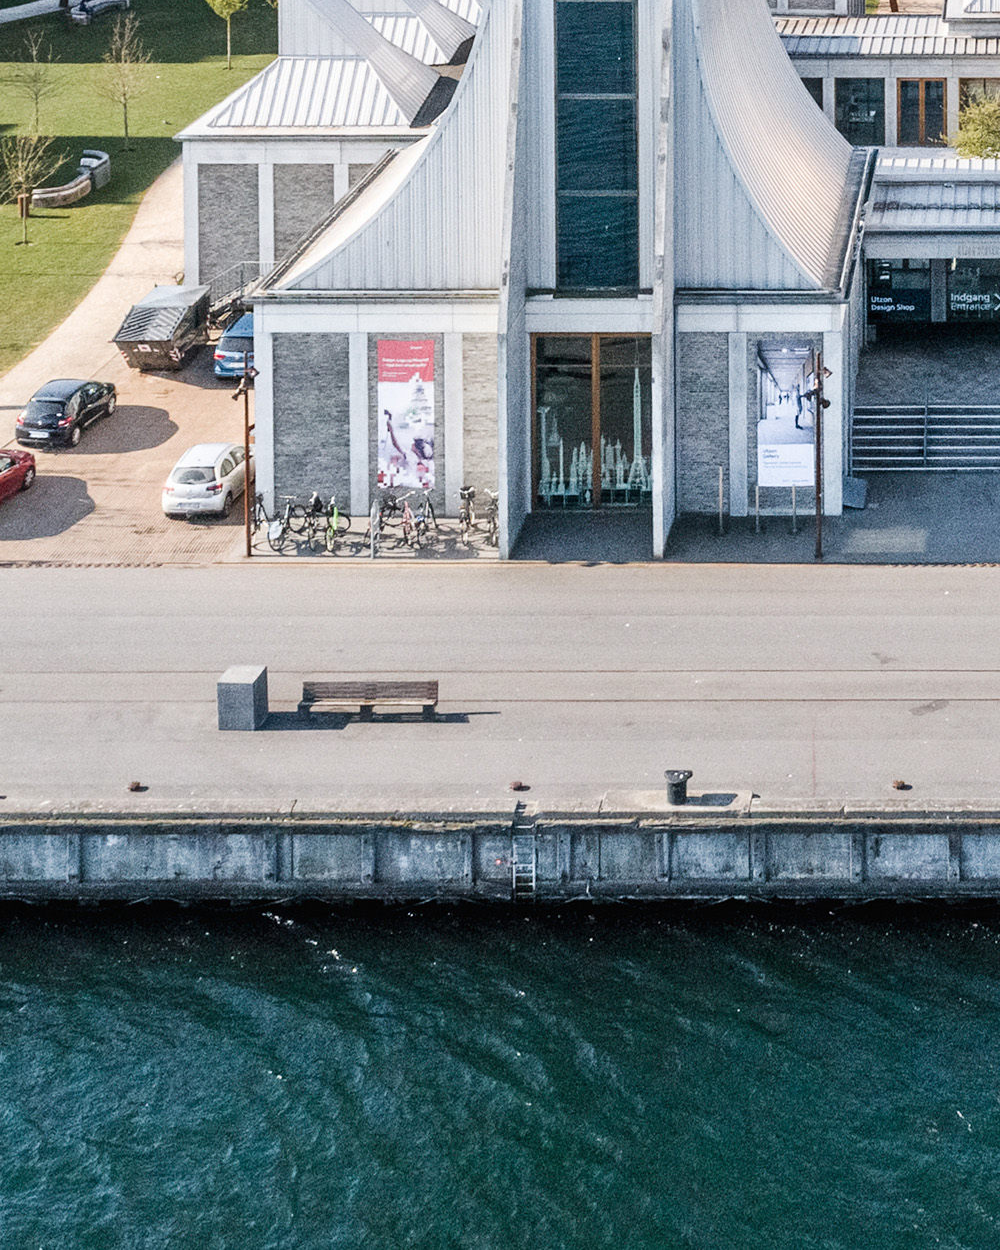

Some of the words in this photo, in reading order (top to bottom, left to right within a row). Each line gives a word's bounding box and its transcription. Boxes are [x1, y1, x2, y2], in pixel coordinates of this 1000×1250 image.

[950, 293, 990, 303] Indgang
[871, 304, 895, 312] Design
[950, 303, 991, 311] Entrance
